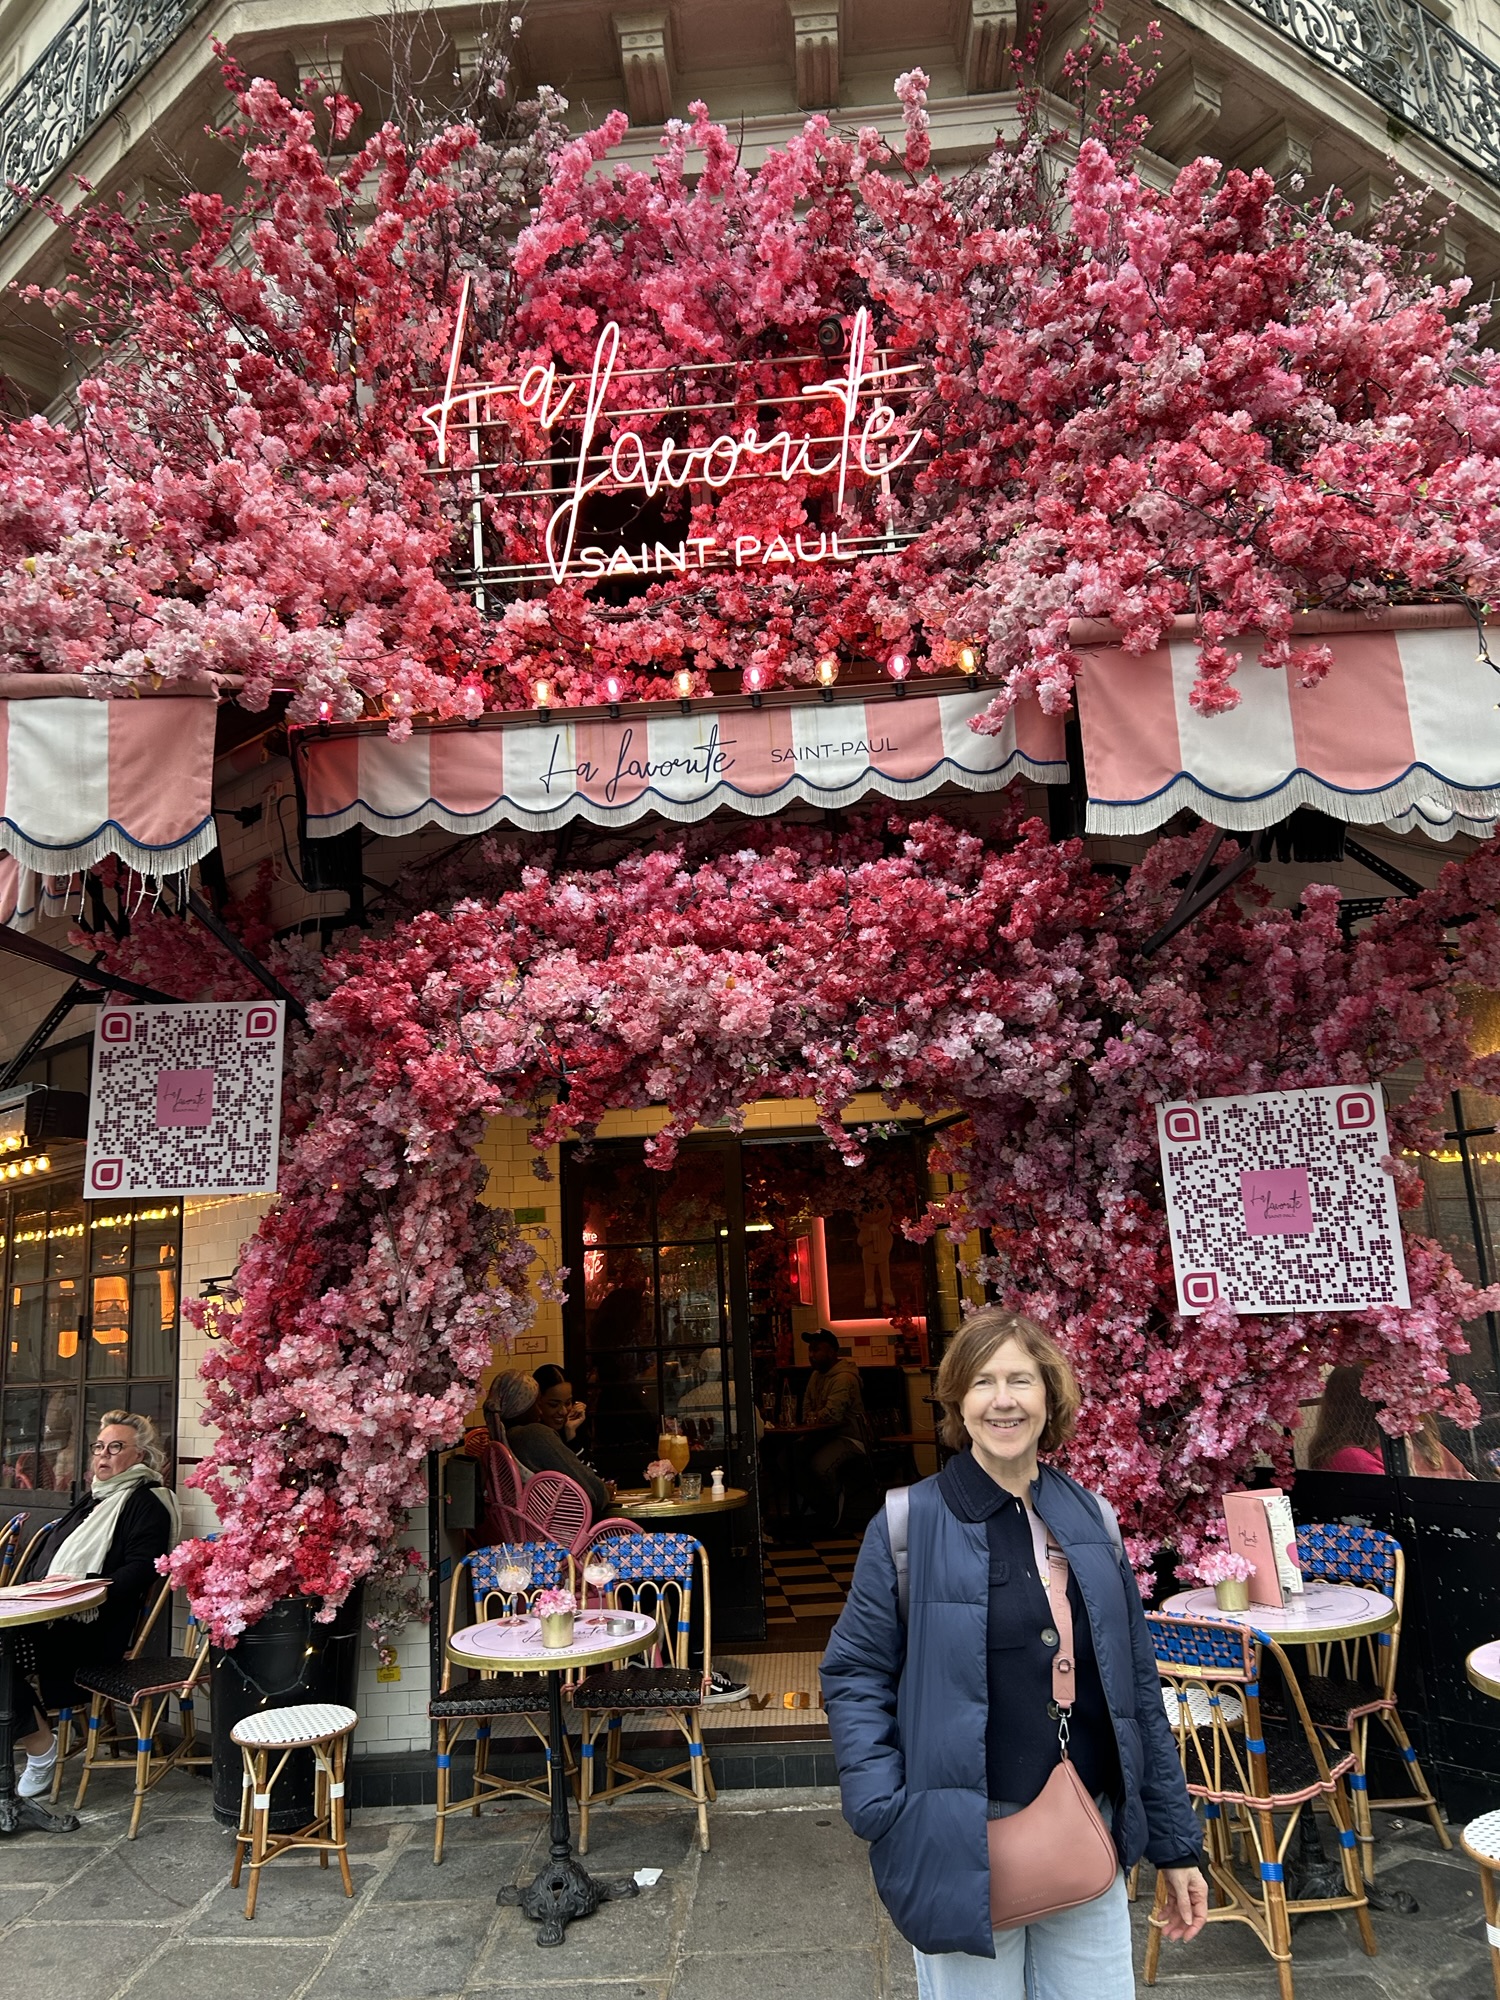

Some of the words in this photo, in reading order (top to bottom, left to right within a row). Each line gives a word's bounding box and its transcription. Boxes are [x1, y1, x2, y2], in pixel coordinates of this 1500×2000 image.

[422, 275, 575, 464] La
[545, 305, 923, 584] favorite
[539, 733, 598, 793] La
[605, 724, 737, 802] favorite
[770, 737, 898, 764] SAINT-PAUL
